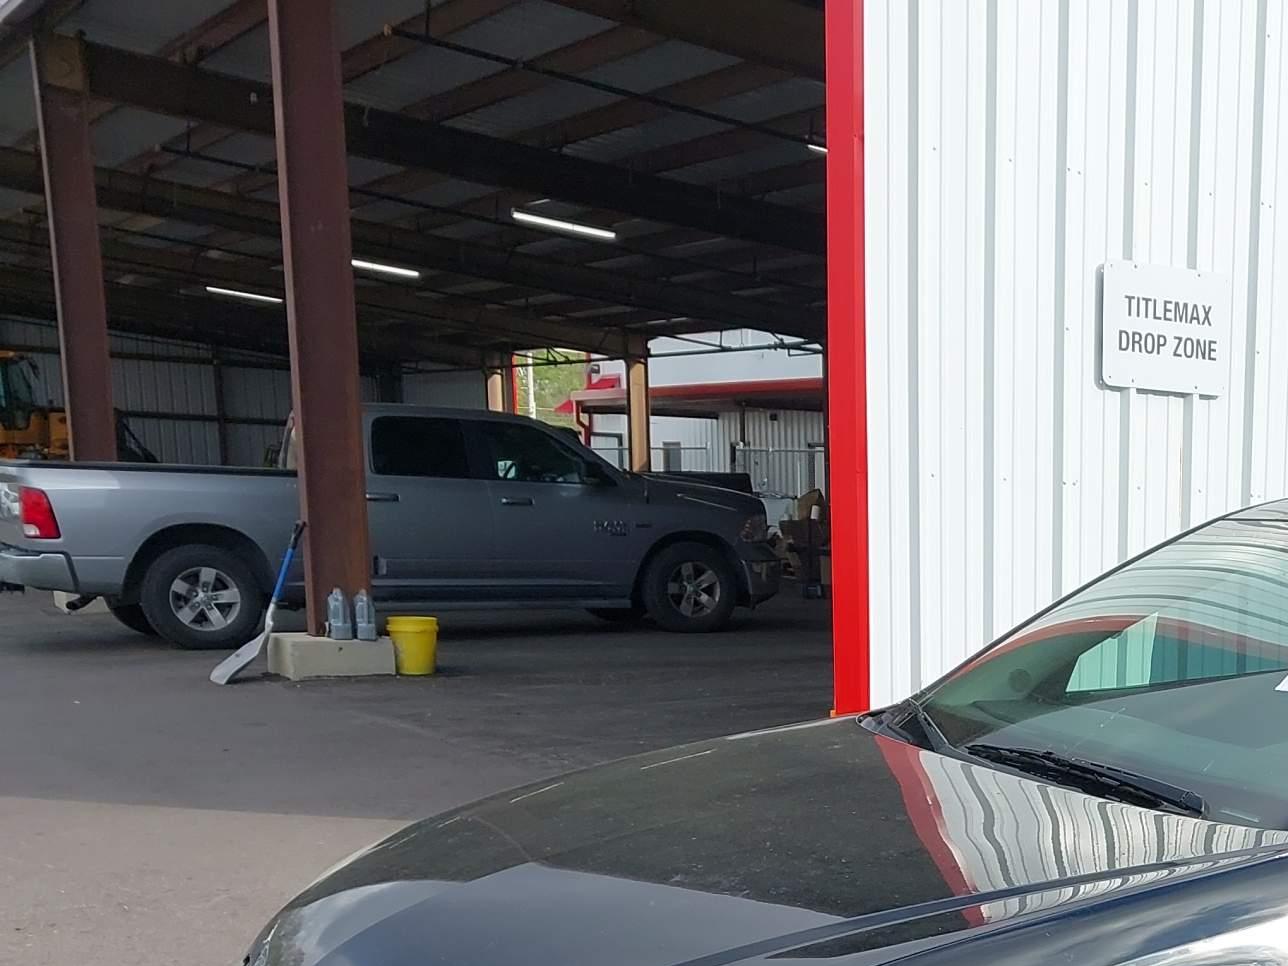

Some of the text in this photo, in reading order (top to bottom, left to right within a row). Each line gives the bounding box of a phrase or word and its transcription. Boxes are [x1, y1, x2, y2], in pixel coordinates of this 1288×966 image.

[1124, 295, 1212, 326] TITLEMAX
[1118, 329, 1217, 361] DROP ZONE
